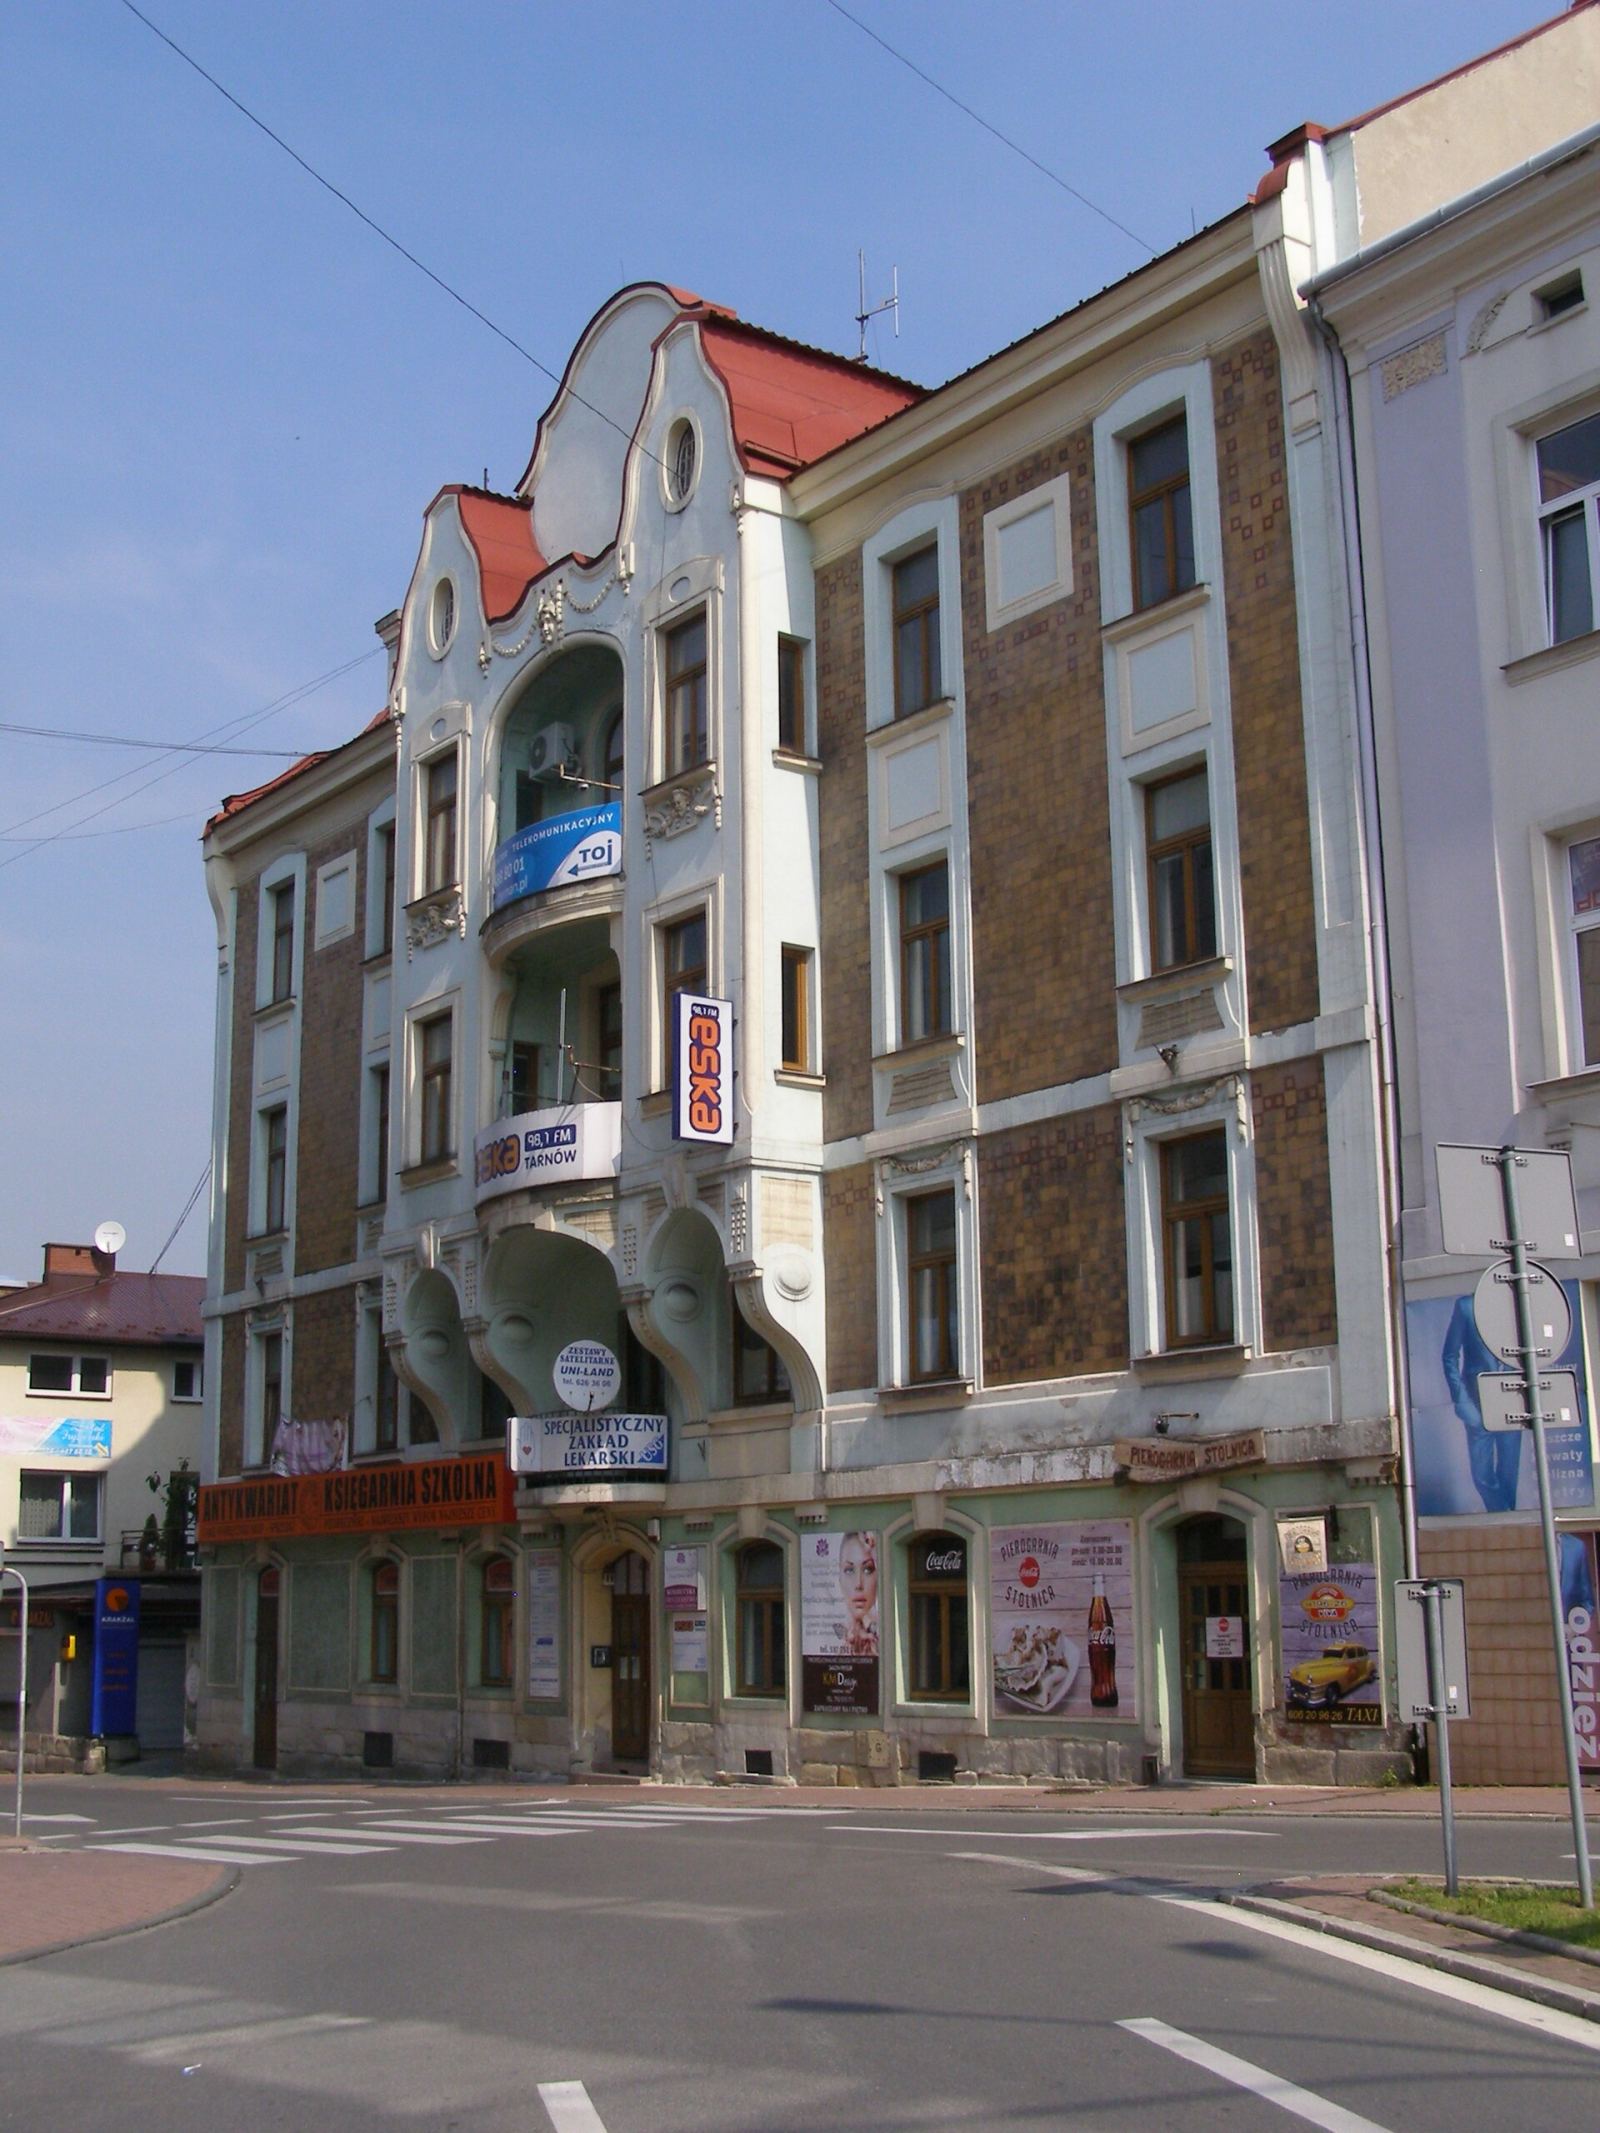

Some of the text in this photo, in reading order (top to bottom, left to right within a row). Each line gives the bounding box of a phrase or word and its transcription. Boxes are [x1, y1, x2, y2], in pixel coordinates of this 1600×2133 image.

[511, 812, 614, 852] TELEKOMUNIKACYJNY
[689, 1015, 722, 1135] eska
[527, 1128, 571, 1147] 98,1 FM
[524, 1148, 577, 1170] TARNÓW
[559, 1355, 615, 1366] SATELITARNE
[568, 1346, 607, 1357] ZESTAWY
[544, 1417, 664, 1436] SPECJALISTYCZNY
[569, 1434, 629, 1450] ZAKŁAD
[564, 1450, 635, 1467] LEKARSKI
[1130, 1438, 1256, 1469] PIEROGARNIA STOLNICA
[203, 1481, 299, 1521] ANTYKWARIAT
[421, 1461, 497, 1504] SZKOLNA
[1000, 1537, 1060, 1561] PIEROGARNIA
[1004, 1585, 1056, 1609] STOLNICA
[1299, 1618, 1360, 1640] STOLNICA
[1347, 1706, 1379, 1721] TAXI
